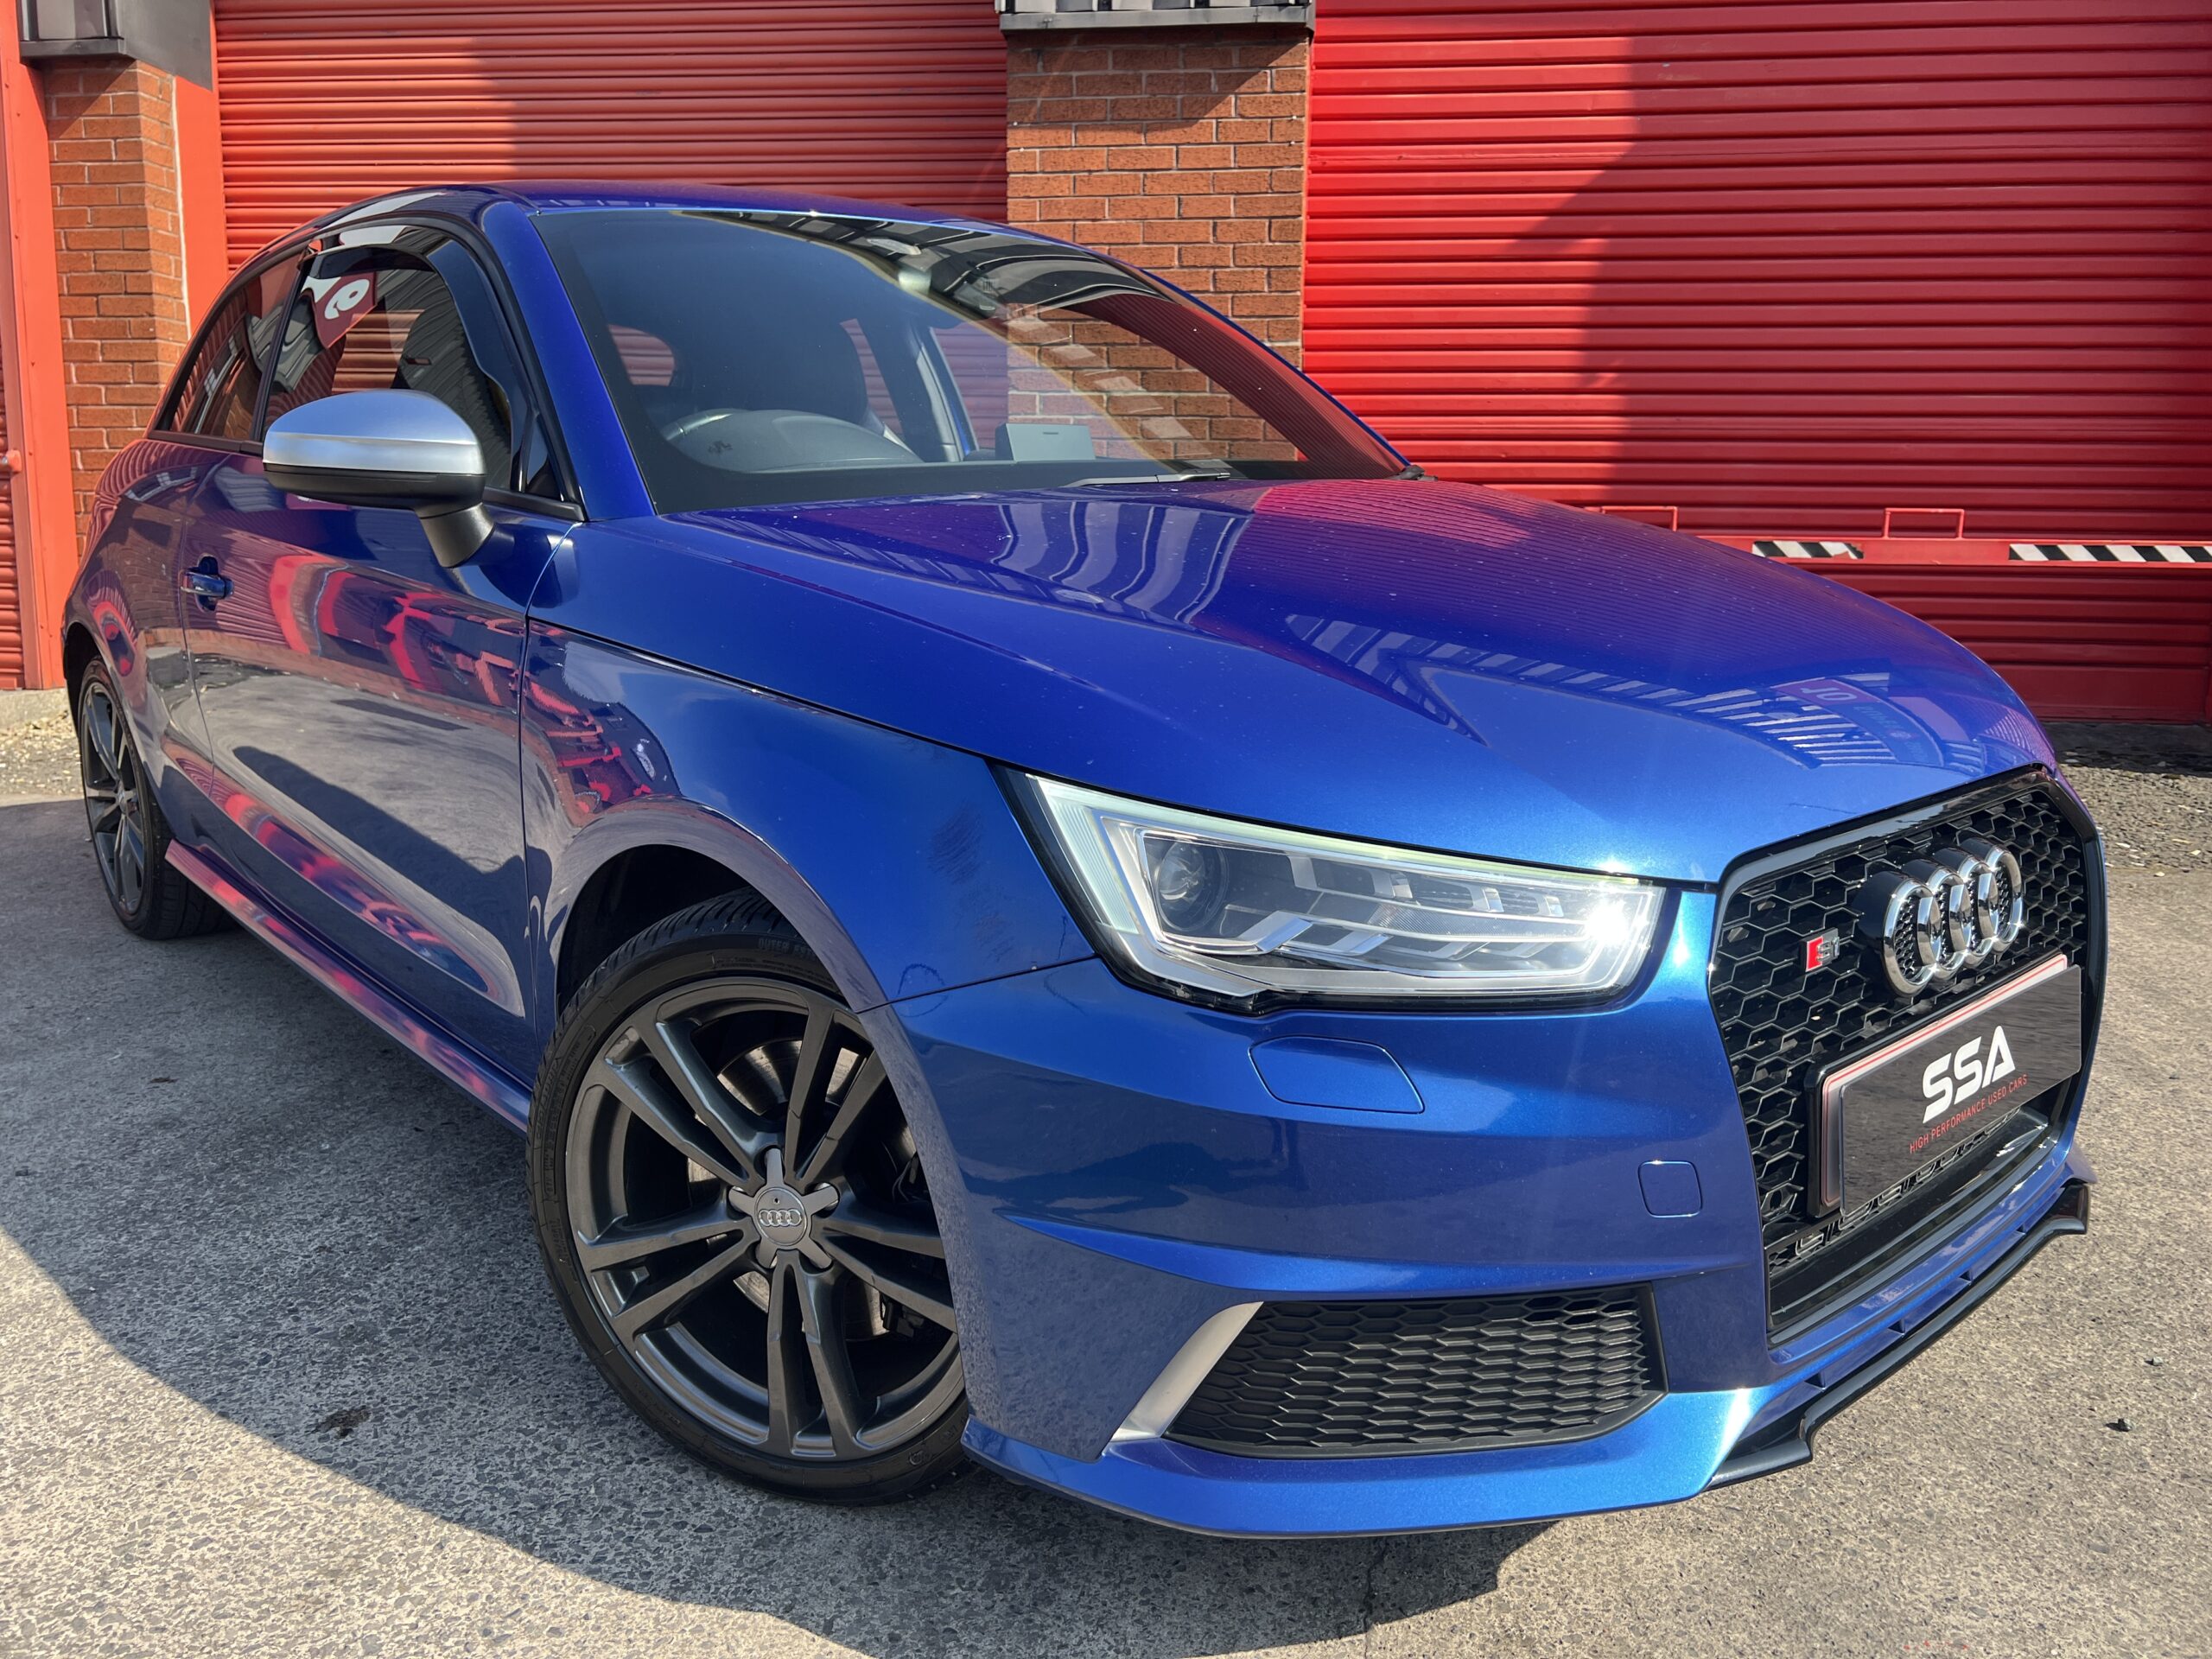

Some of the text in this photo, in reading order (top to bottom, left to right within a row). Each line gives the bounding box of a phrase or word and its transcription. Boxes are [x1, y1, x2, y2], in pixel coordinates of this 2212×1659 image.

[1910, 1074, 2028, 1154] HIGH PERFORMANCE USED CARS
[1923, 1026, 2016, 1123] SSA
